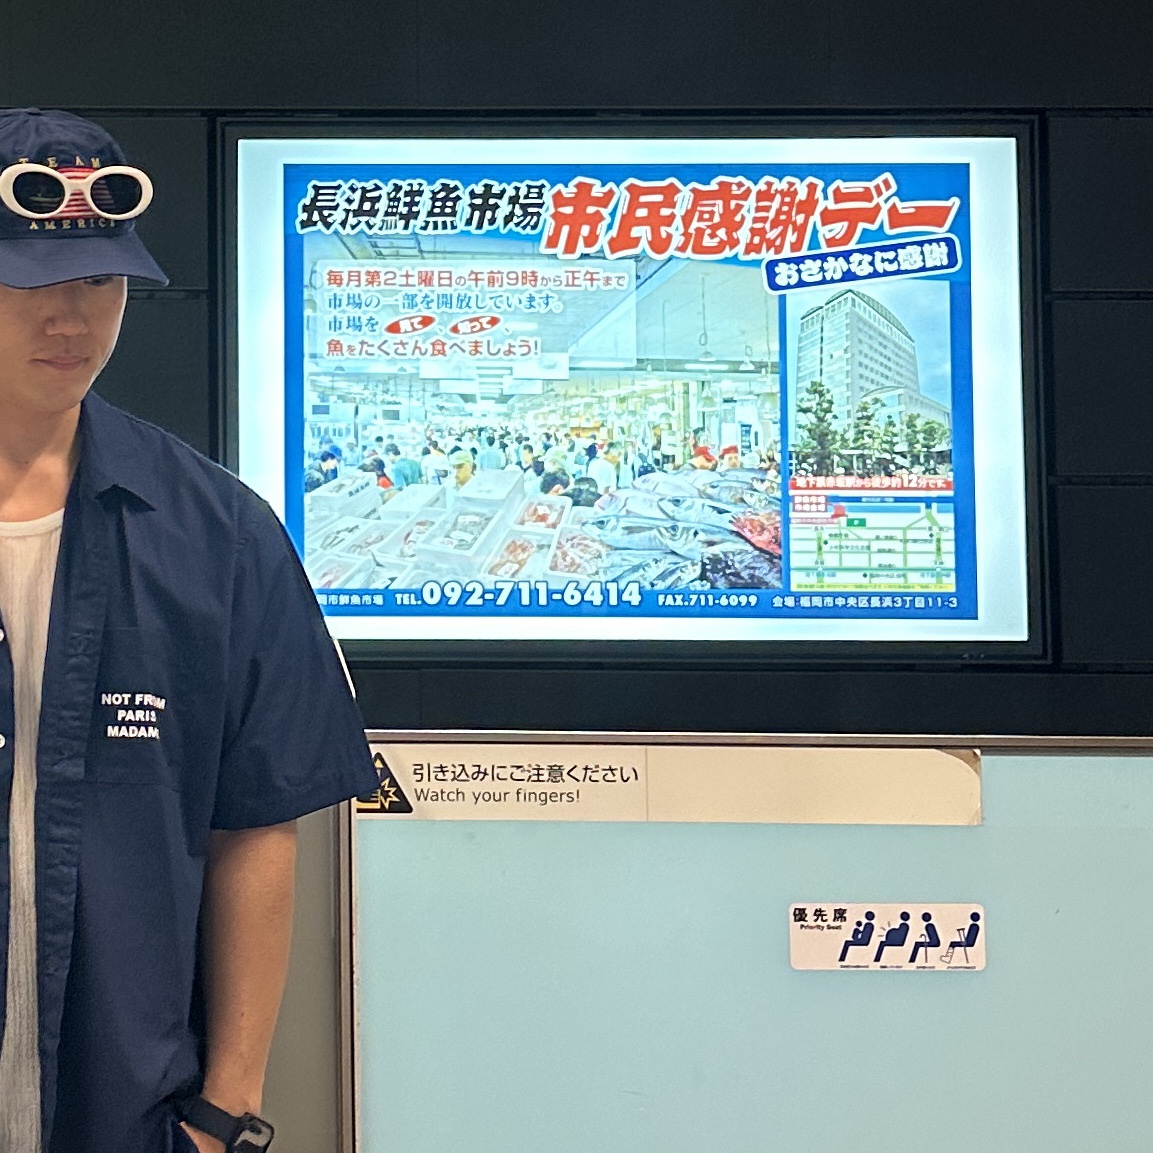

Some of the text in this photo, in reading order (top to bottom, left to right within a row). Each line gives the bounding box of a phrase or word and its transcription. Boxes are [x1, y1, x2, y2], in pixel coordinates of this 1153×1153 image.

[18, 155, 101, 169] TEAM
[298, 175, 957, 257] 長浜鮮魚市場 市民感謝デー
[774, 241, 949, 286] おさかなに感謝
[326, 269, 626, 288] 毎月第2土曜日の午前9時から正午まで
[328, 292, 563, 310] 市場の一部を開放しています。
[326, 339, 538, 356] 魚をたくさん食べましょう!
[657, 593, 758, 607] FAX.711-6099
[101, 693, 131, 705] NOT
[107, 725, 160, 739] MADAM
[412, 762, 639, 783] 引き込みにご注意ください
[414, 787, 580, 806] Watch your fingers!
[793, 907, 847, 922] 優先席
